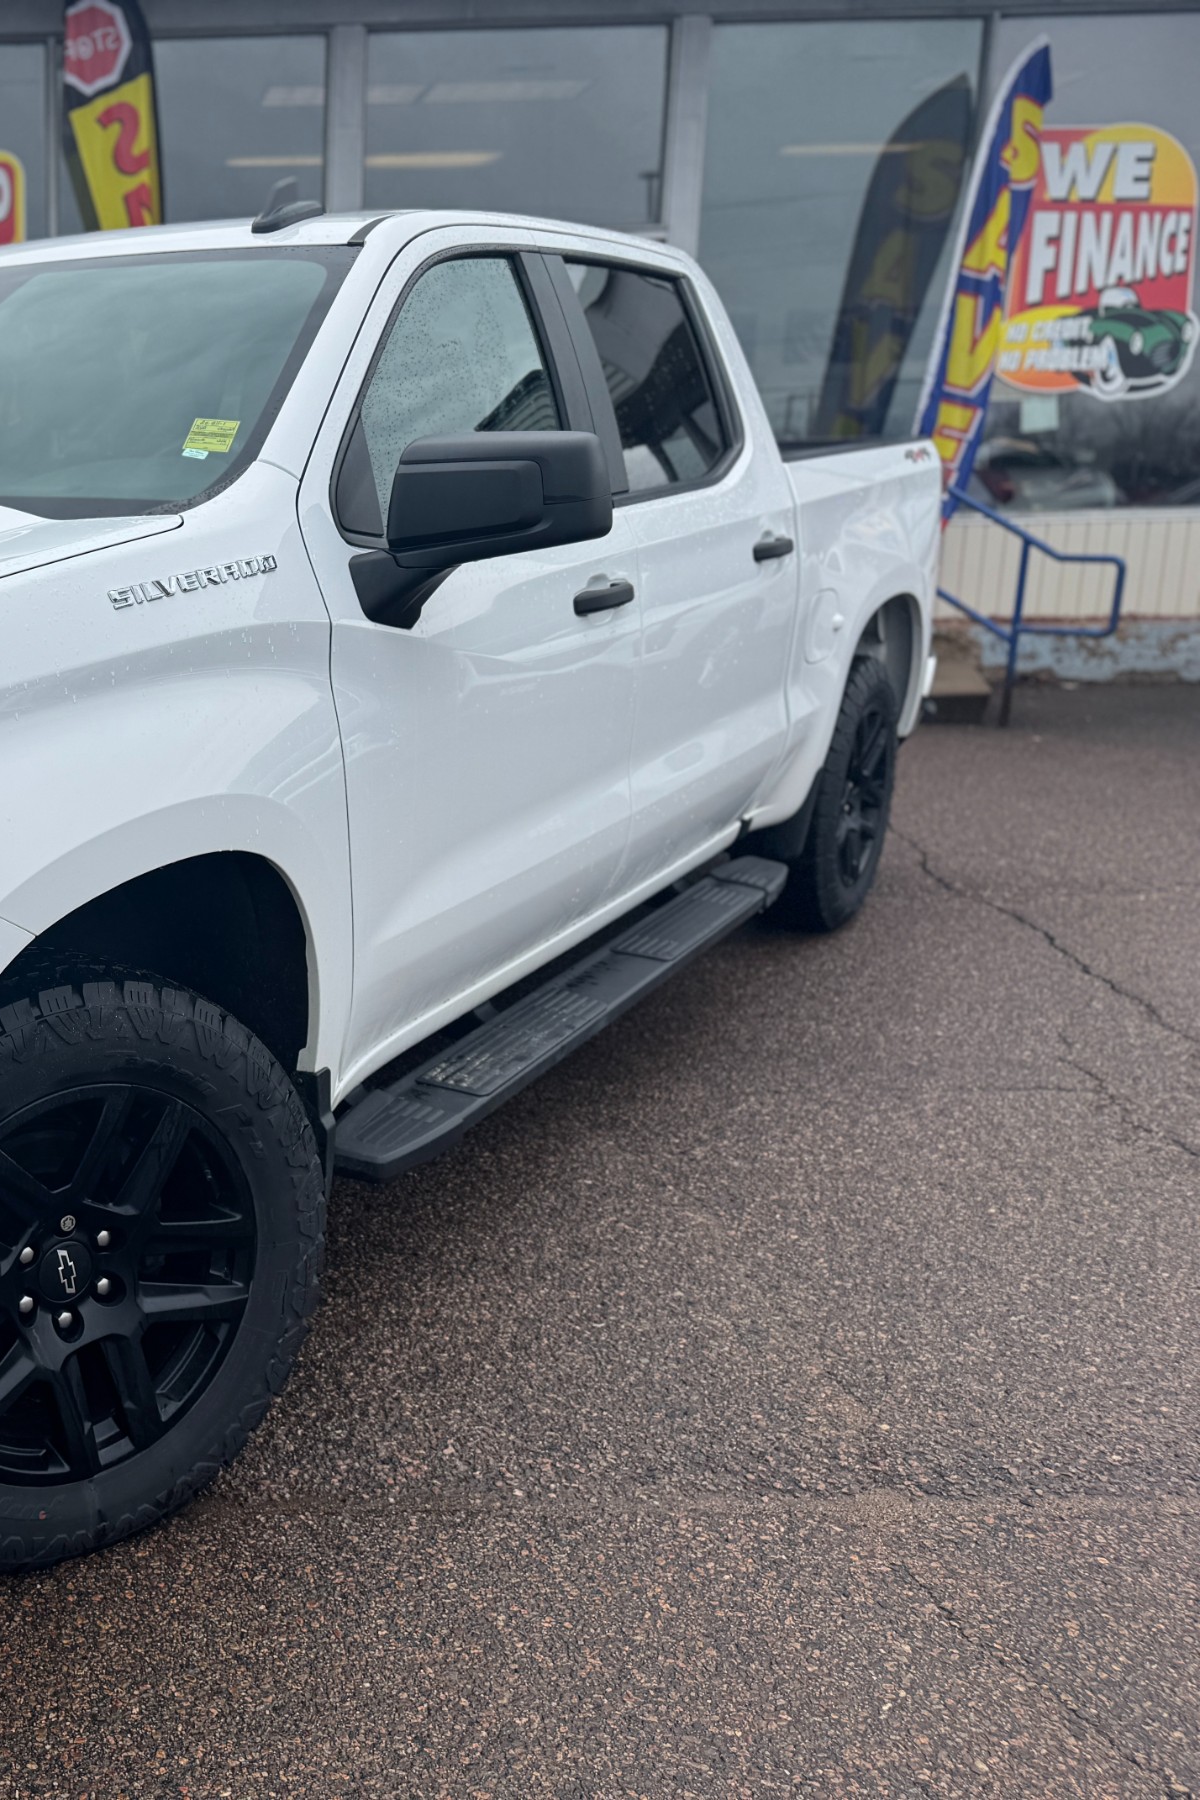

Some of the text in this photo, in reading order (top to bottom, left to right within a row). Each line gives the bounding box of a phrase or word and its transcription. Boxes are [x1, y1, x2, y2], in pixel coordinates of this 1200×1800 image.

[1040, 142, 1156, 201] WE
[1025, 211, 1191, 305] FINANCE
[107, 554, 277, 610] SILVERADO
